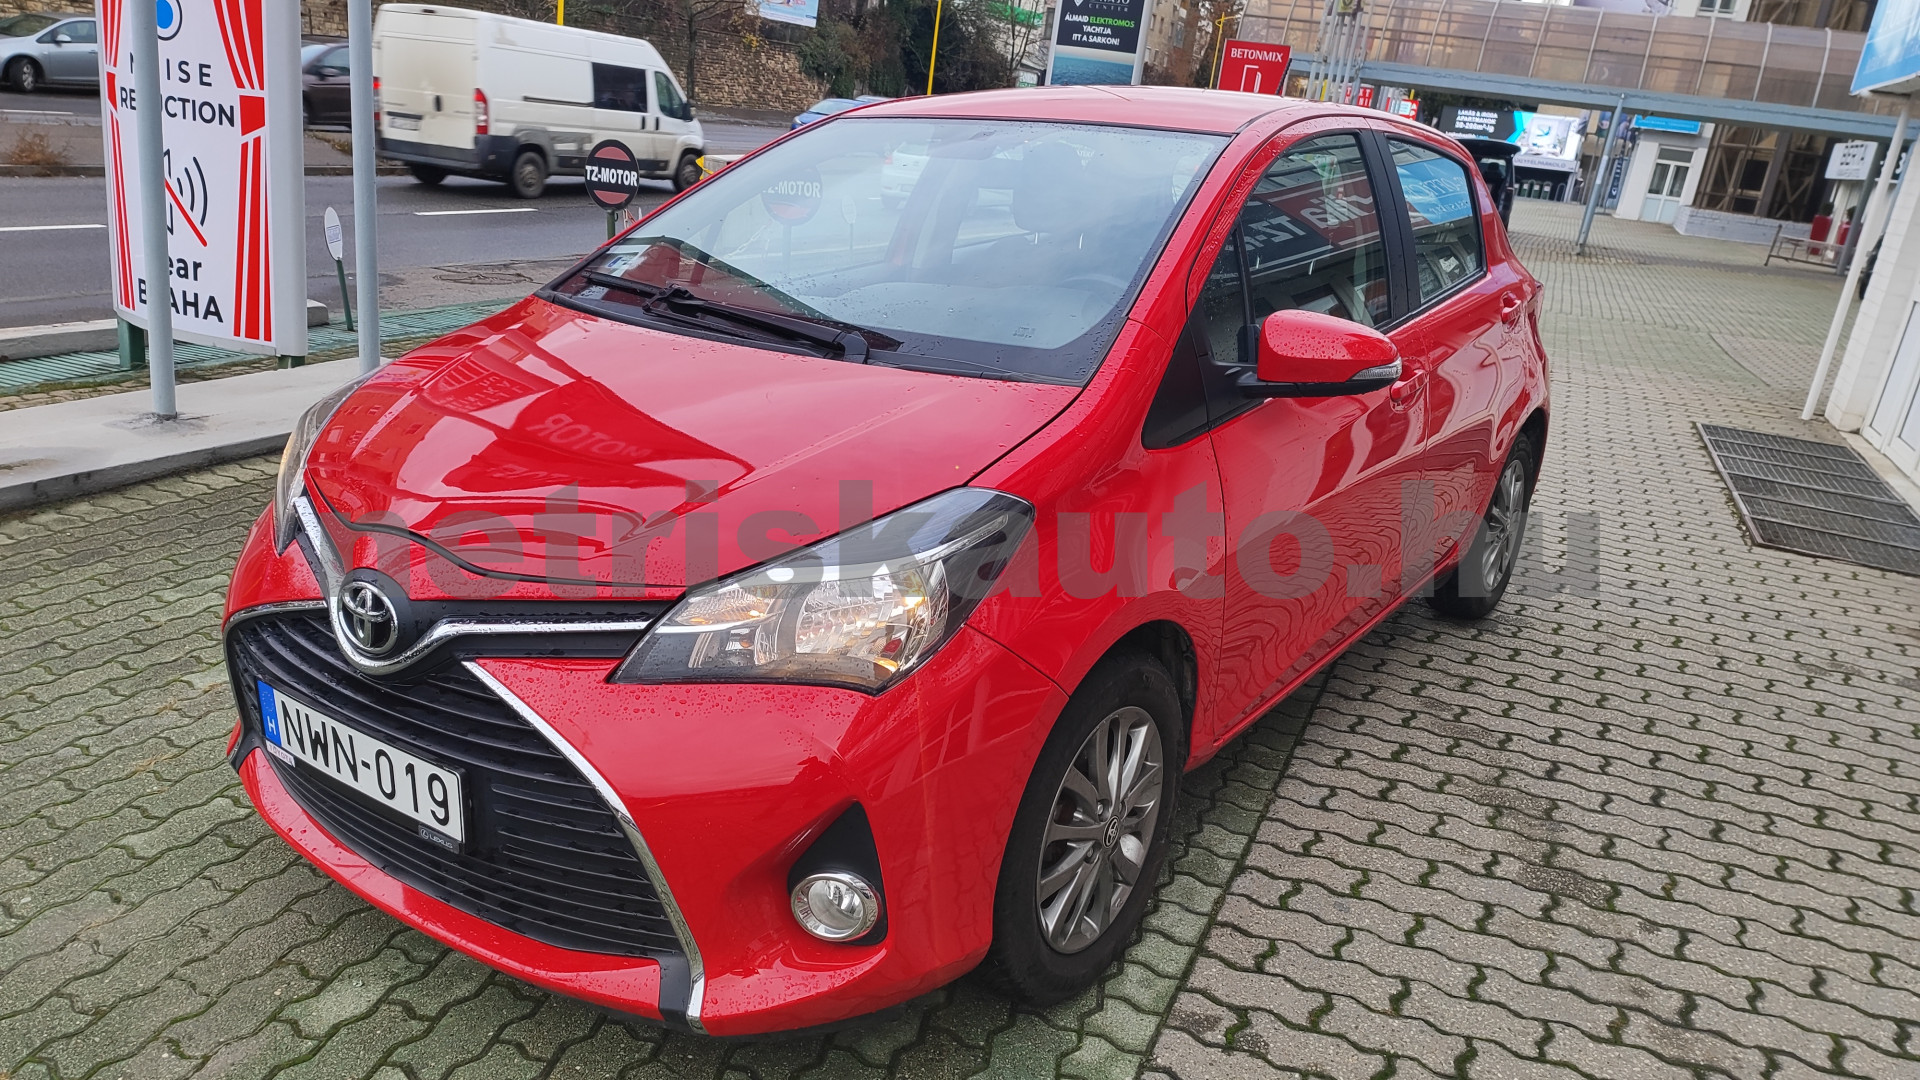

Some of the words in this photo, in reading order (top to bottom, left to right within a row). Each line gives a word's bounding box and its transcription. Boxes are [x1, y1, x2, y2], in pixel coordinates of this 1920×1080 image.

[1064, 12, 1089, 23] ÁLMAID
[1089, 16, 1135, 28] ELEKTROMOS
[1082, 25, 1112, 35] YACHTJA
[1072, 33, 1082, 42] ITT
[1088, 36, 1120, 46] SARKON!
[1230, 47, 1284, 62] BETONMIX
[130, 52, 212, 87] ISE
[120, 86, 235, 127] RECTION
[585, 165, 638, 187] TZ-MOTOR
[762, 180, 821, 198] Z-MOTOR
[138, 278, 224, 323] BAHA
[266, 715, 277, 736] H
[281, 699, 451, 827] NWN-019
